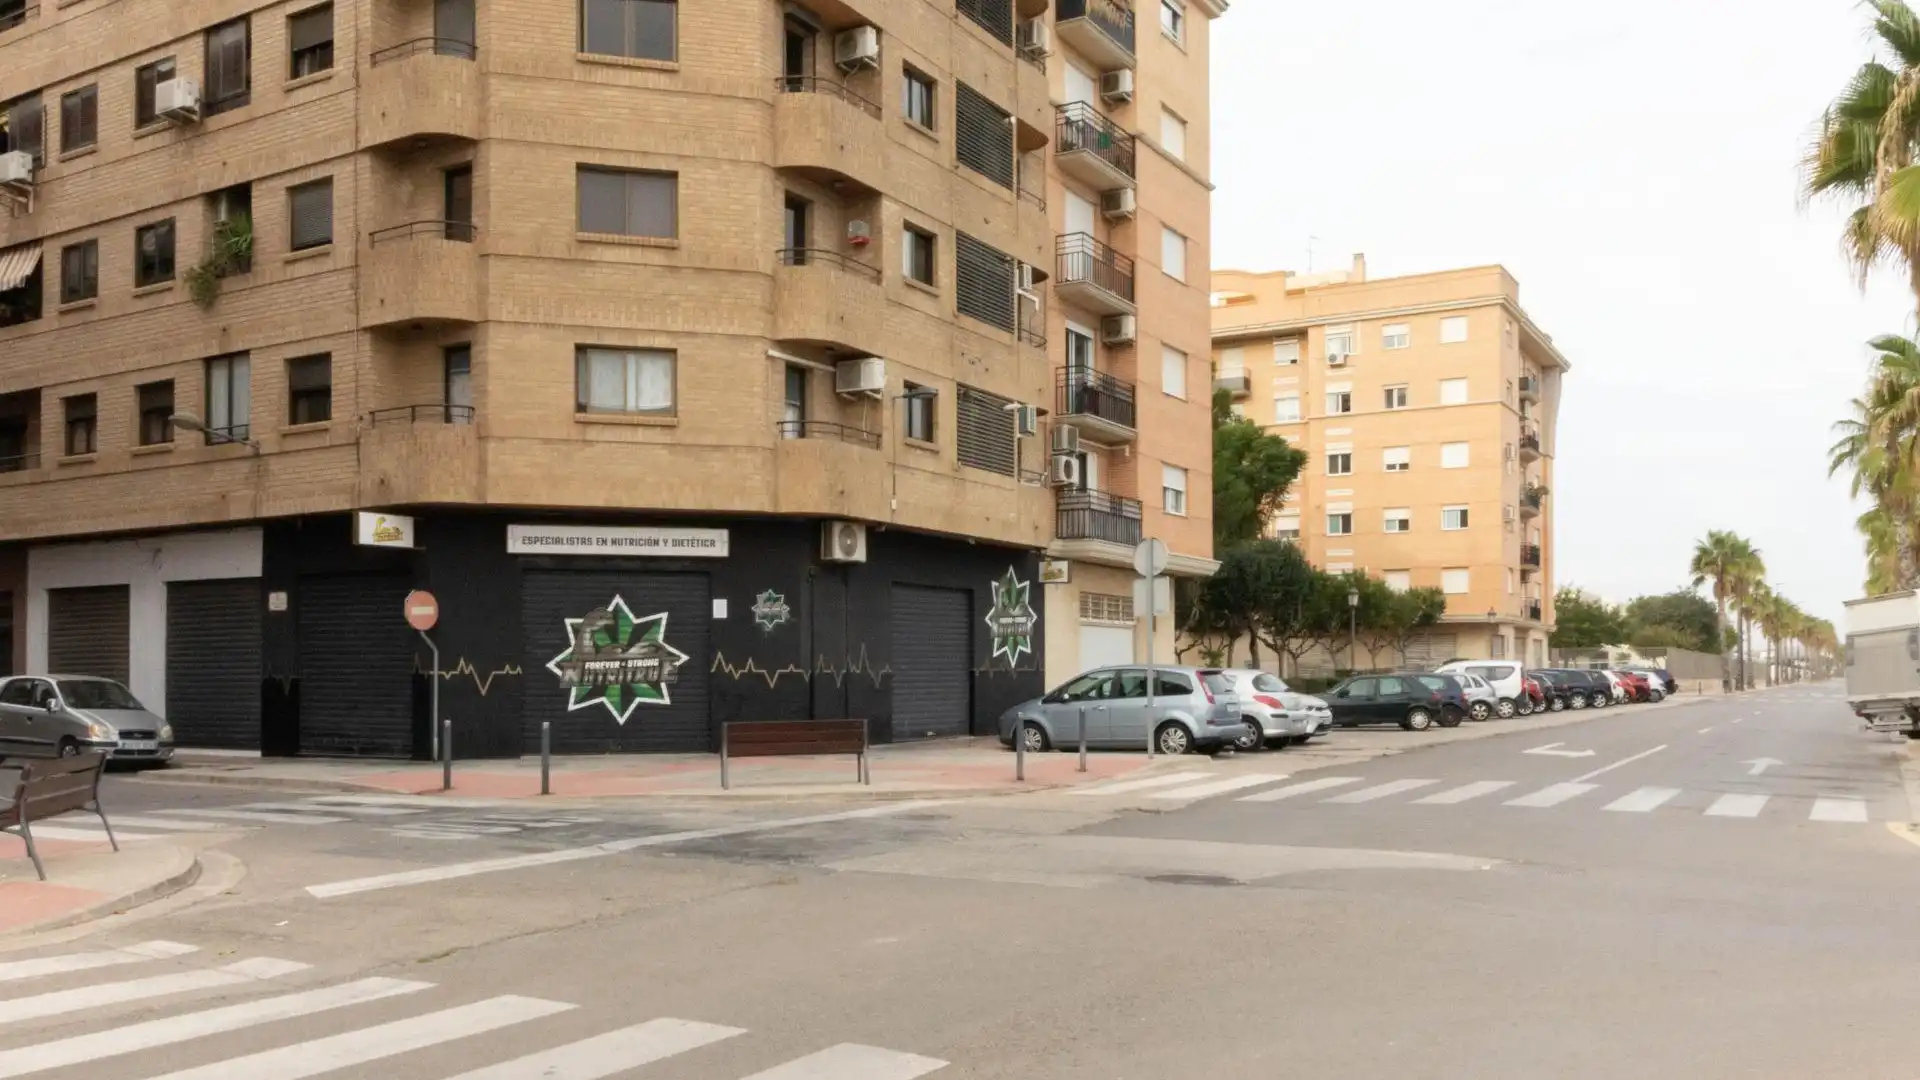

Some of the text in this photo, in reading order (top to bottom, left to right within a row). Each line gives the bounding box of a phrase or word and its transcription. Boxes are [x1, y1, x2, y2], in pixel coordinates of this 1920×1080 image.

[522, 536, 716, 548] ESPECIALISTAS EN NUTRICIÓN Y DIETÉTICA
[584, 658, 659, 669] FOREVER STRONG
